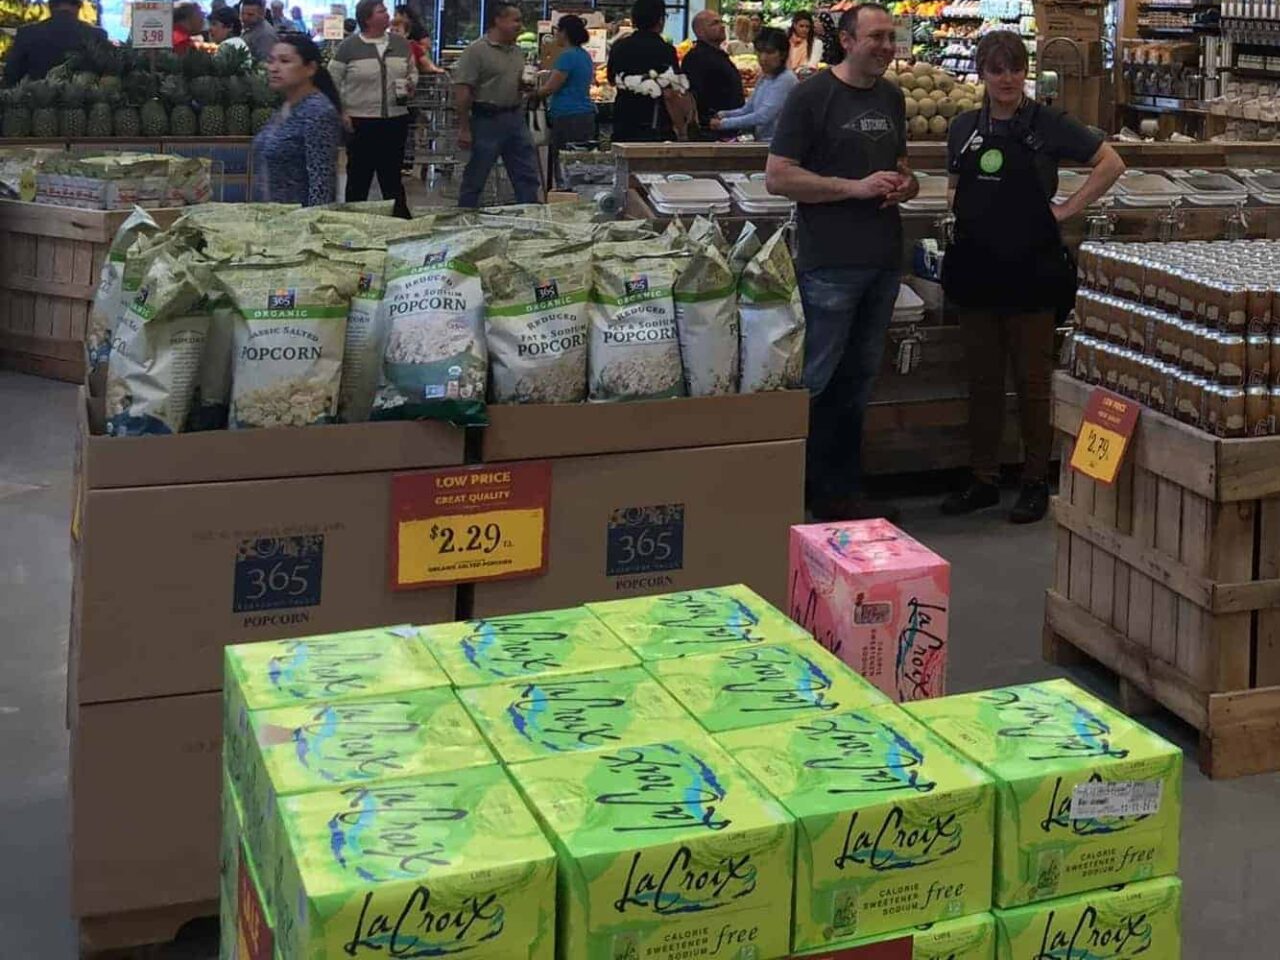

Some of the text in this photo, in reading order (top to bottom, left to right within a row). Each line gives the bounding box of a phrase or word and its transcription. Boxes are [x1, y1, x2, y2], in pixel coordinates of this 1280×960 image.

[254, 309, 308, 318] ORGANIC
[389, 298, 467, 317] POPCORN
[526, 296, 572, 312] ORGANIC
[527, 313, 577, 330] REDUCED
[436, 471, 511, 488] LOW PRICE
[434, 491, 510, 505] GREAT QUALITY
[430, 523, 501, 554] $2.29
[618, 530, 672, 564] 365
[246, 561, 310, 599] 365
[616, 575, 673, 591] POPCORN
[243, 612, 309, 628] POPCORN
[835, 806, 956, 869] LaCroix
[1115, 846, 1155, 873] free
[614, 846, 750, 912] LaCroix
[920, 881, 964, 910] free
[344, 886, 497, 956] LaCroix
[1033, 906, 1146, 960] LaCroix
[709, 924, 758, 955] free
